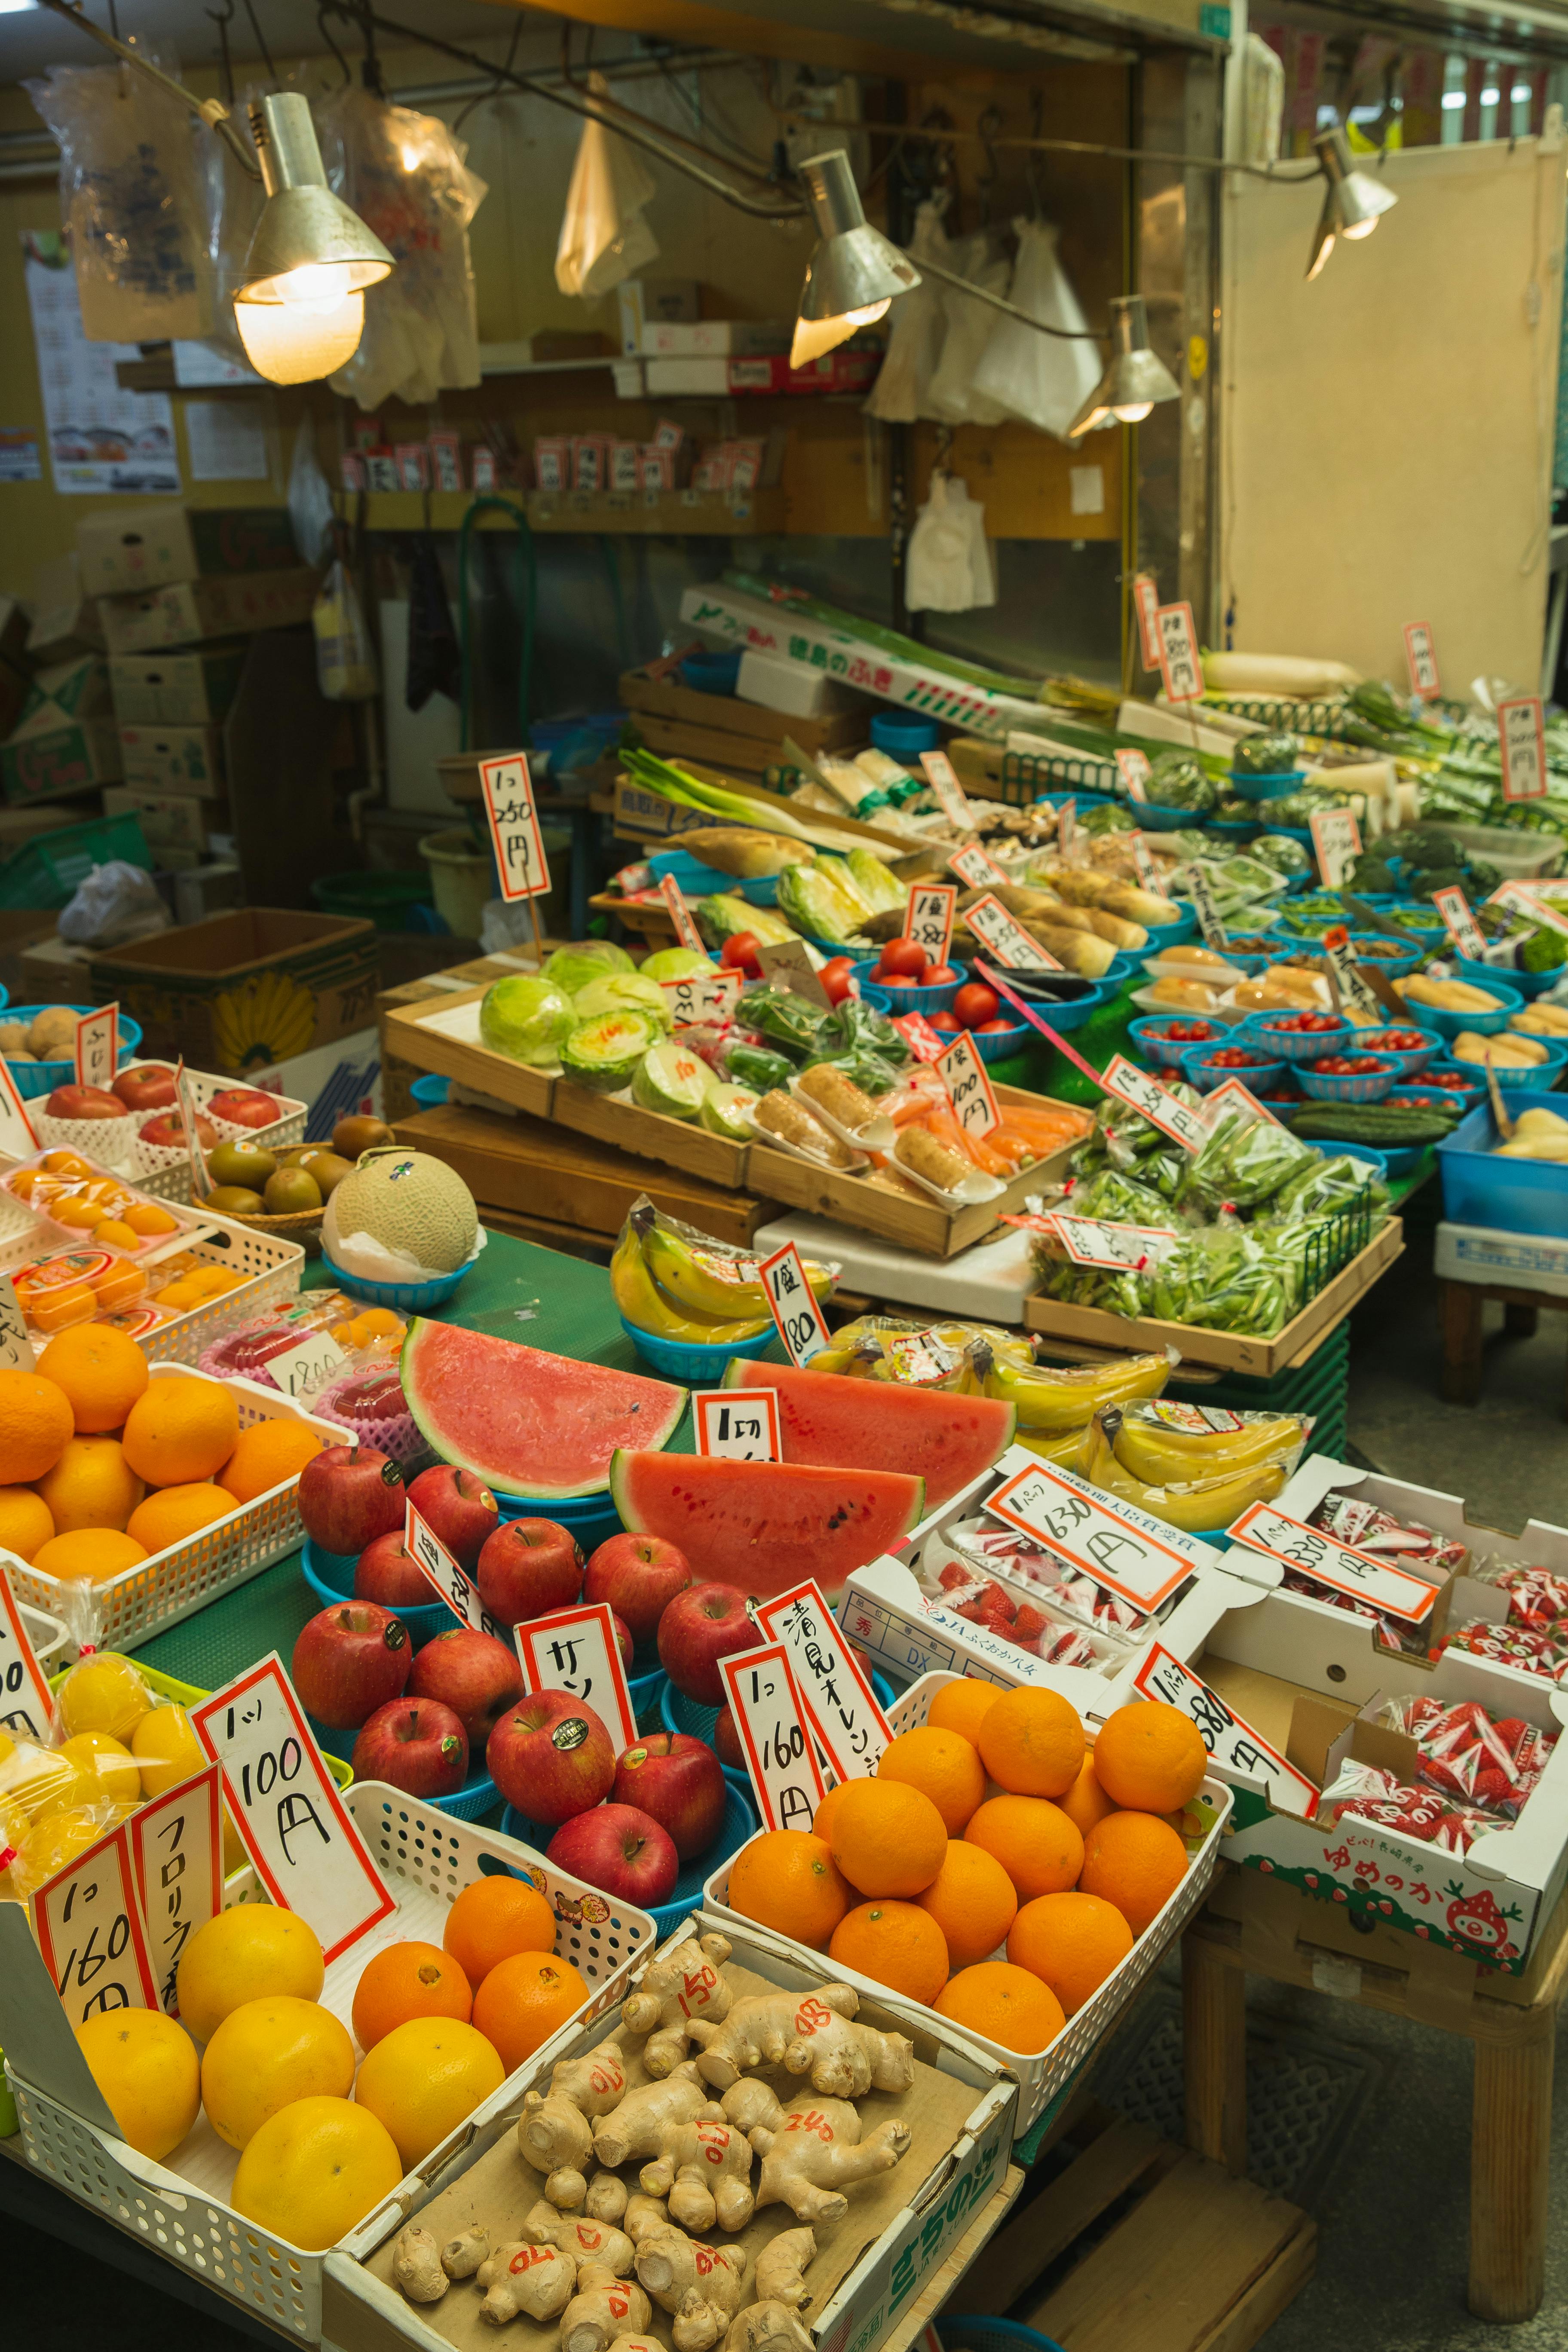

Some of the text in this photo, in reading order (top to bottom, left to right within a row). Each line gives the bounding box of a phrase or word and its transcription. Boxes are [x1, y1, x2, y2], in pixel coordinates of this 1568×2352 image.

[493, 799, 532, 824] 250
[507, 835, 529, 868] 円
[989, 921, 1018, 949] 250
[674, 983, 693, 1025] 130
[952, 1073, 977, 1109] 100
[963, 1098, 988, 1129] 円
[290, 1354, 337, 1397] 1800
[718, 1408, 761, 1441] 1切
[1009, 1484, 1045, 1513] 1パック
[1044, 1497, 1091, 1540] 630
[1086, 1531, 1148, 1574] 円
[1283, 1535, 1328, 1568] 330
[1338, 1553, 1378, 1578] 円
[856, 1599, 883, 1618] 品位
[855, 1616, 873, 1637] 秀
[906, 1646, 931, 1672] DX
[0, 1661, 23, 1693] 0
[751, 1670, 775, 1704] 1コ
[227, 1699, 262, 1740] 1ツ
[1190, 1686, 1234, 1753] 580
[764, 1720, 805, 1771] 160
[242, 1736, 302, 1807] 100
[780, 1786, 814, 1834] 円
[277, 1793, 331, 1866] 円
[1323, 1845, 1445, 1905] ゆめのか
[1379, 1841, 1424, 1874] 長崎県産
[63, 1882, 98, 1923] 1コ
[59, 1914, 130, 1997] 160
[677, 1965, 717, 2018] 150
[784, 2110, 834, 2142] 240
